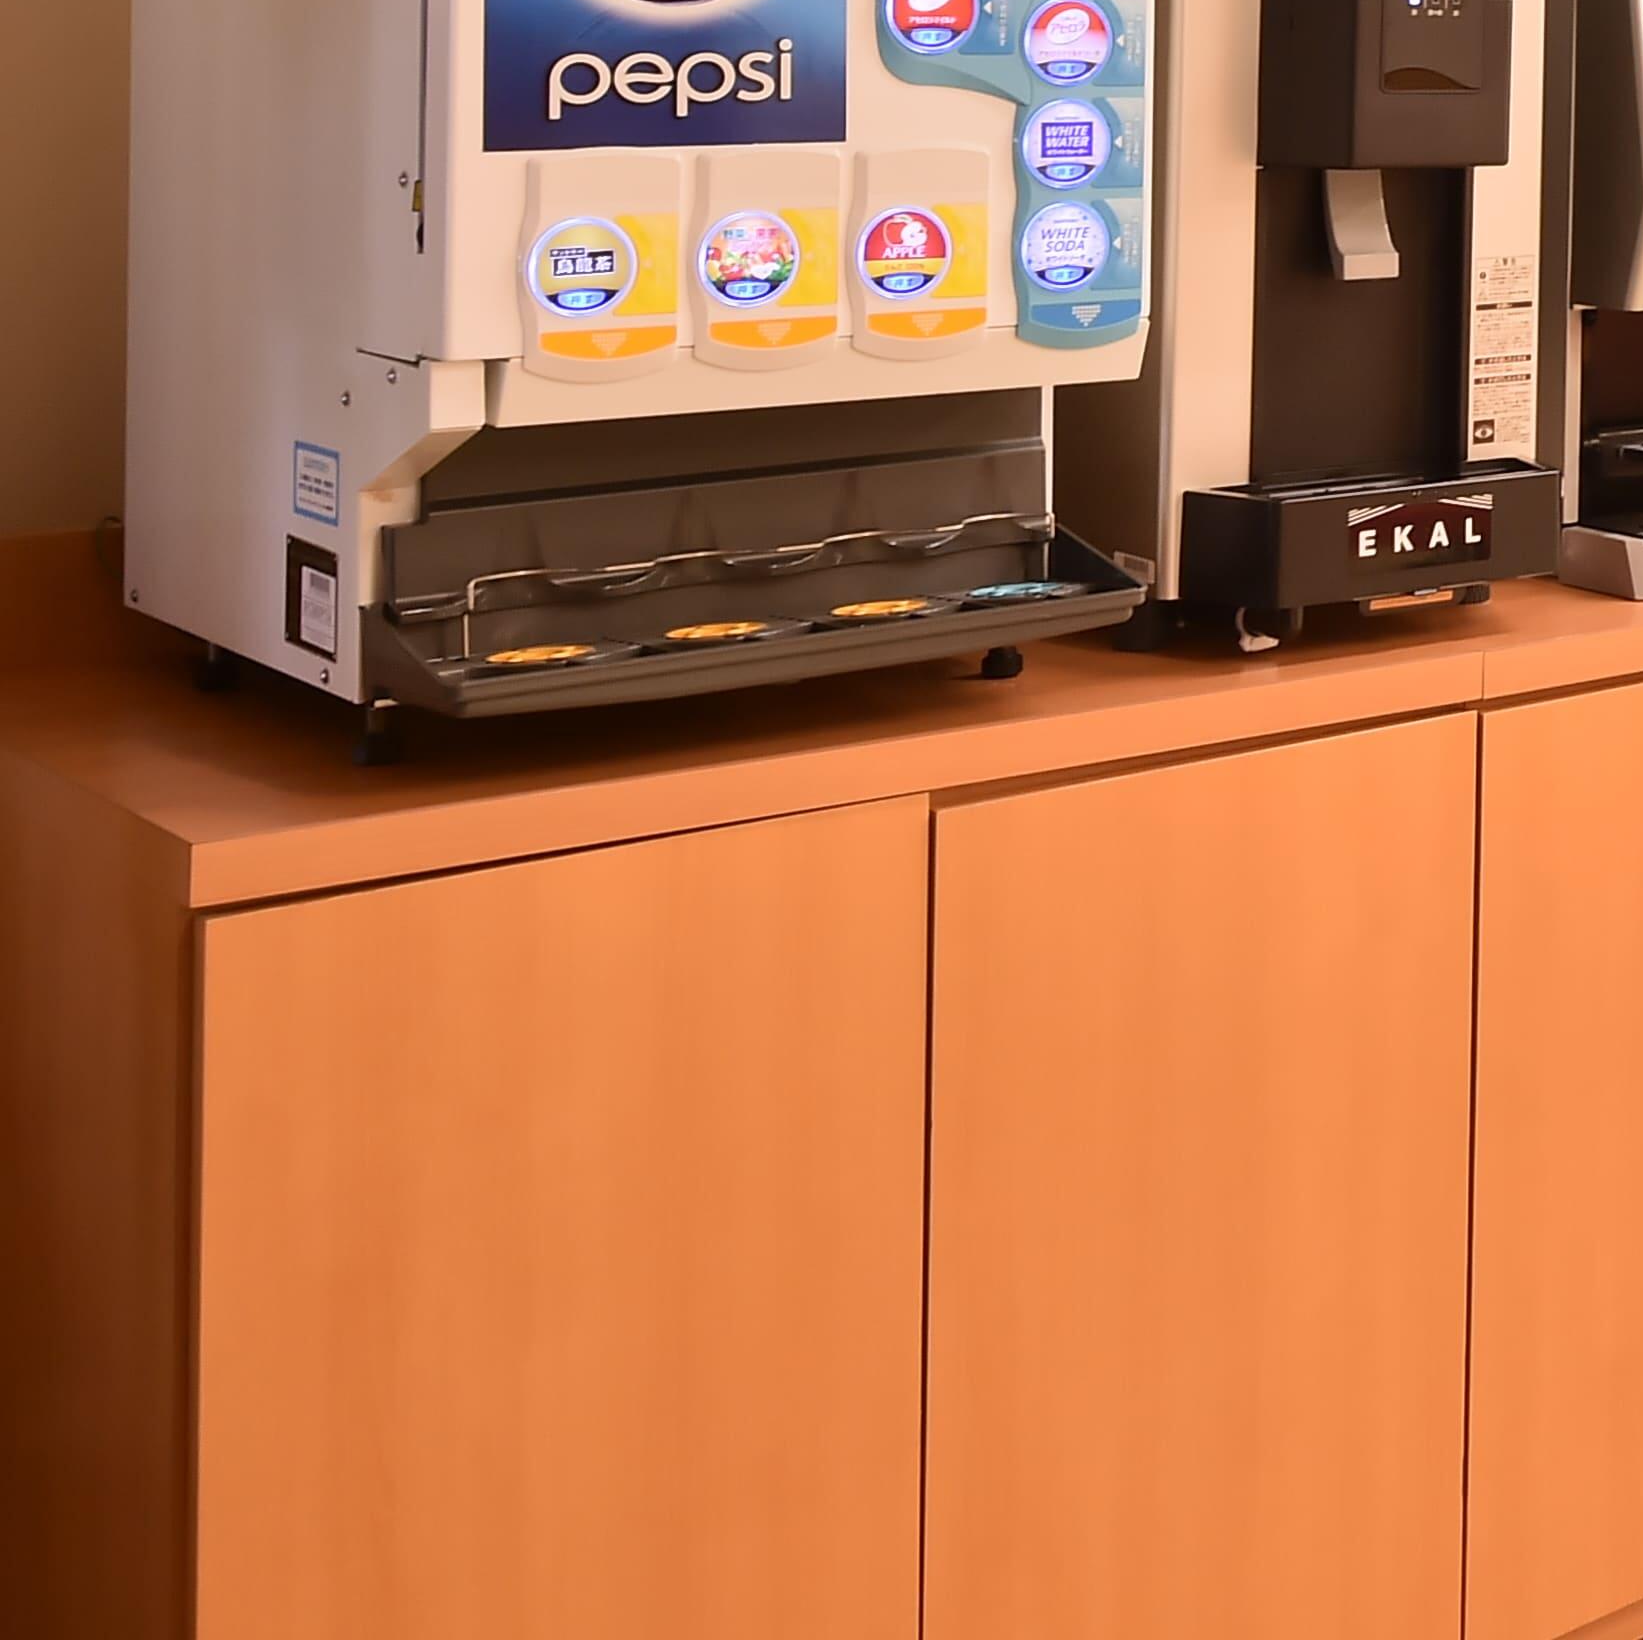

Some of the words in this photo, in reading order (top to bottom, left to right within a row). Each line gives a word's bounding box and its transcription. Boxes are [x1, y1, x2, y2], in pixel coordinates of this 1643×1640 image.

[547, 39, 794, 121] pepsi
[1045, 125, 1090, 137] WHITE
[1046, 136, 1090, 148] WATER
[1041, 226, 1091, 240] WHITE
[882, 245, 927, 258] APPLE
[1045, 240, 1086, 253] SODA
[1358, 517, 1482, 558] EKAL
